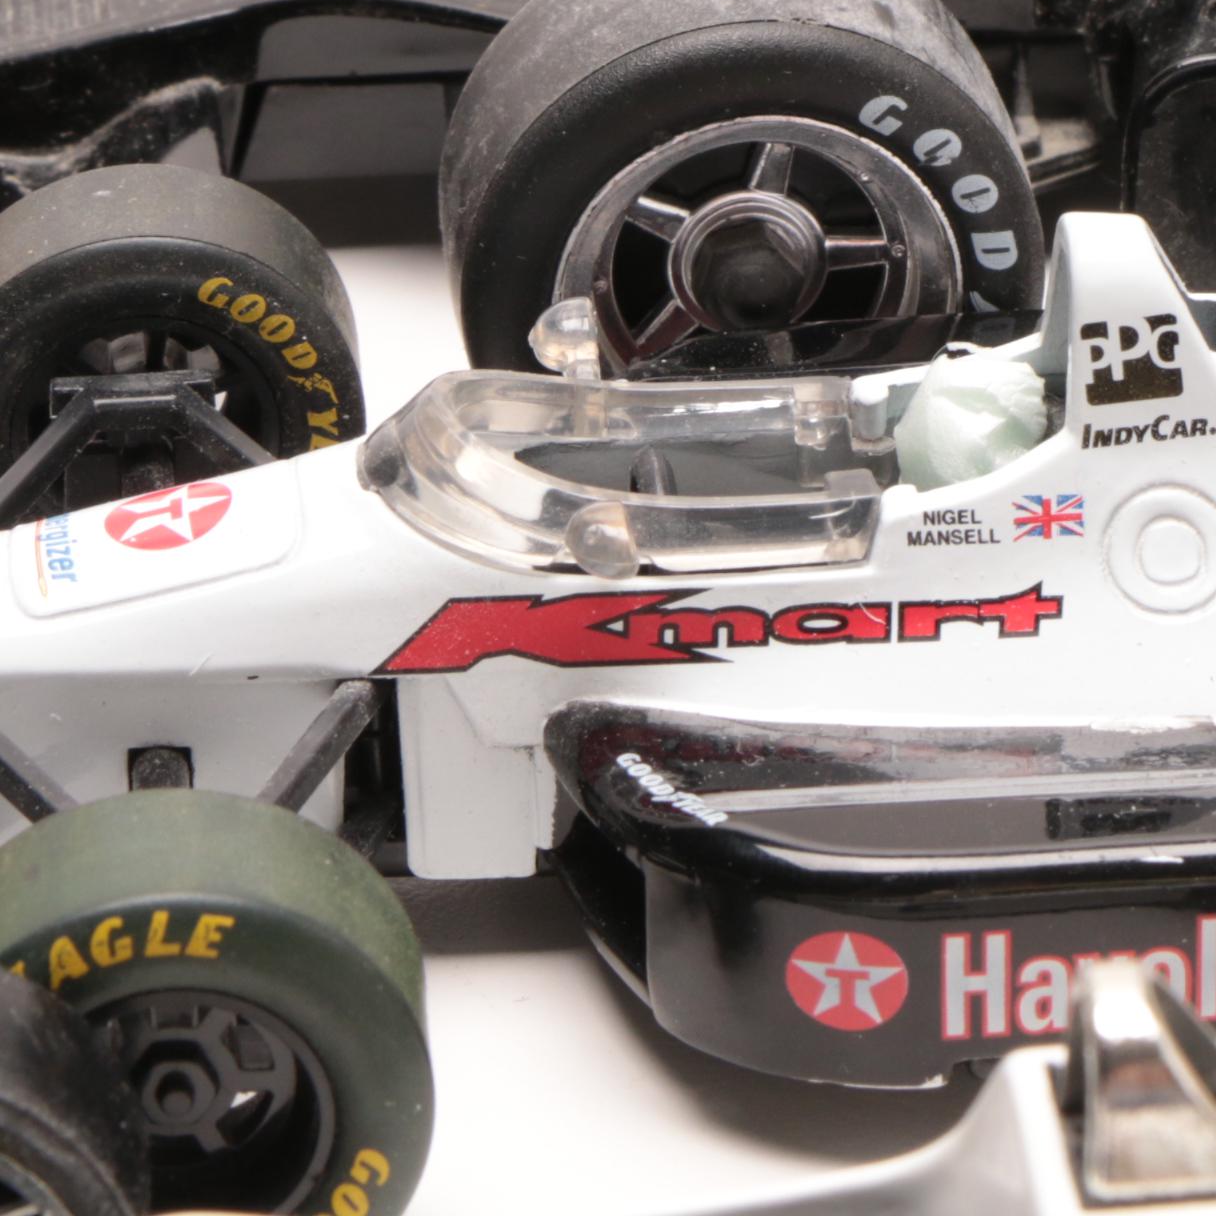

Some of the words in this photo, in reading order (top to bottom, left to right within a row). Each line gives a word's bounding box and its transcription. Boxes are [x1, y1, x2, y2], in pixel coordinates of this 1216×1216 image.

[197, 275, 342, 451] GOODY
[1080, 314, 1185, 384] PPG
[906, 528, 1001, 548] MANSELL
[922, 509, 983, 527] NIGEL
[368, 582, 1063, 676] Kmart
[10, 910, 236, 990] AGLE
